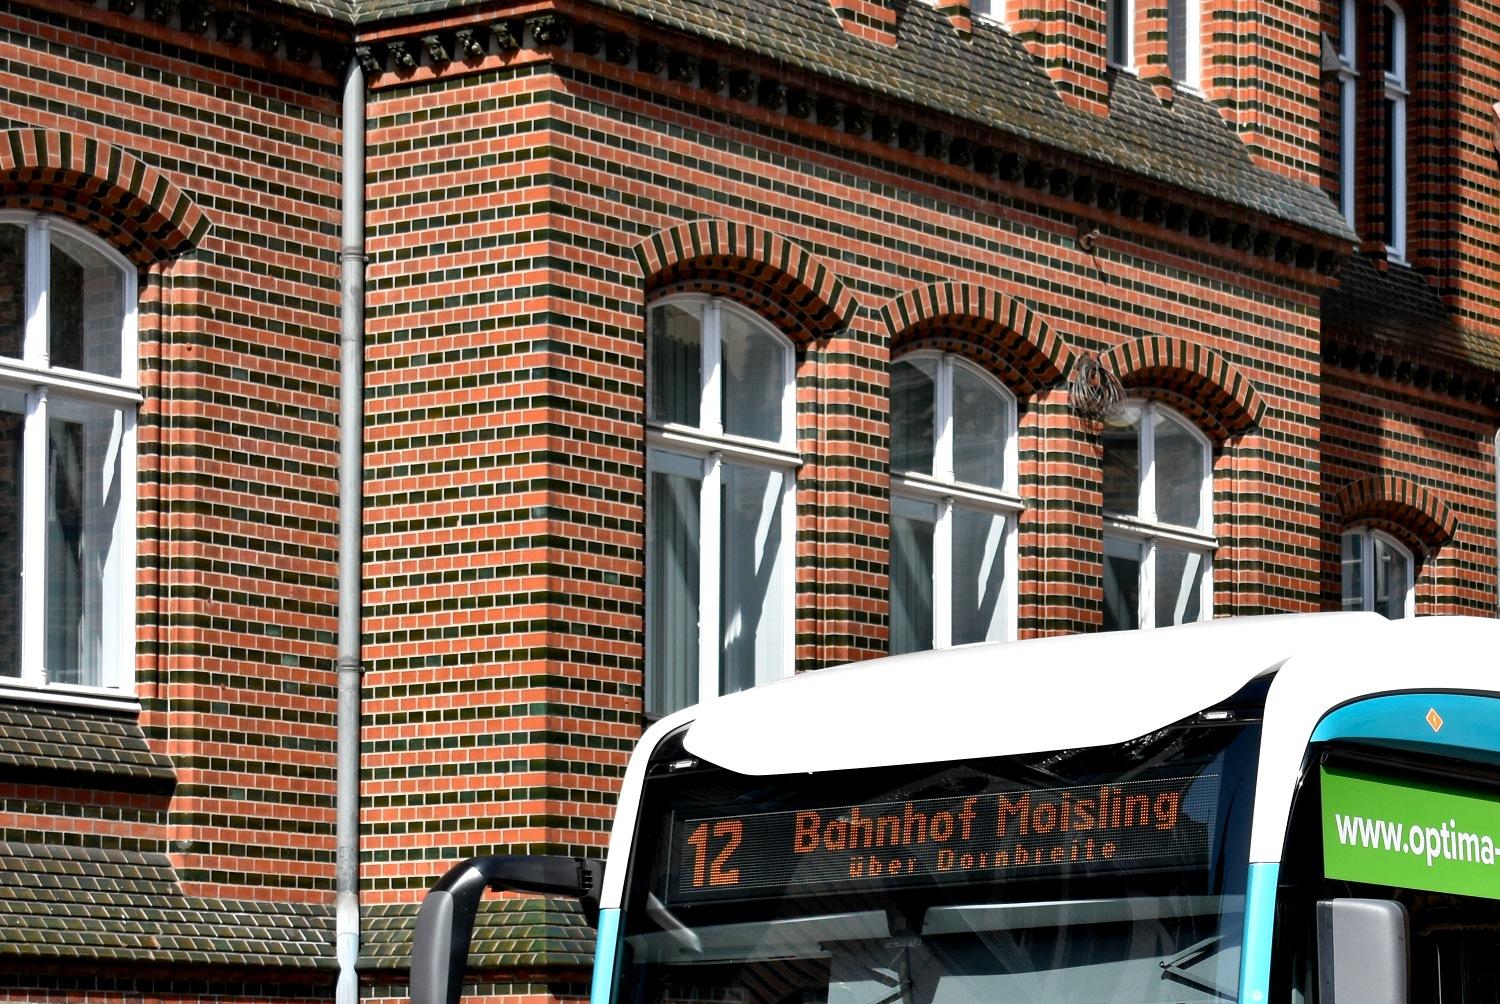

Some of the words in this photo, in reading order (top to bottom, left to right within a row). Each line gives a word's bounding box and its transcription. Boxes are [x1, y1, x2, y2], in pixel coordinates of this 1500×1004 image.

[688, 820, 744, 888] 12
[793, 797, 978, 854] Bahnhof
[998, 786, 1180, 838] Moisling
[850, 854, 916, 879] über
[938, 837, 1118, 872] Dornbreite
